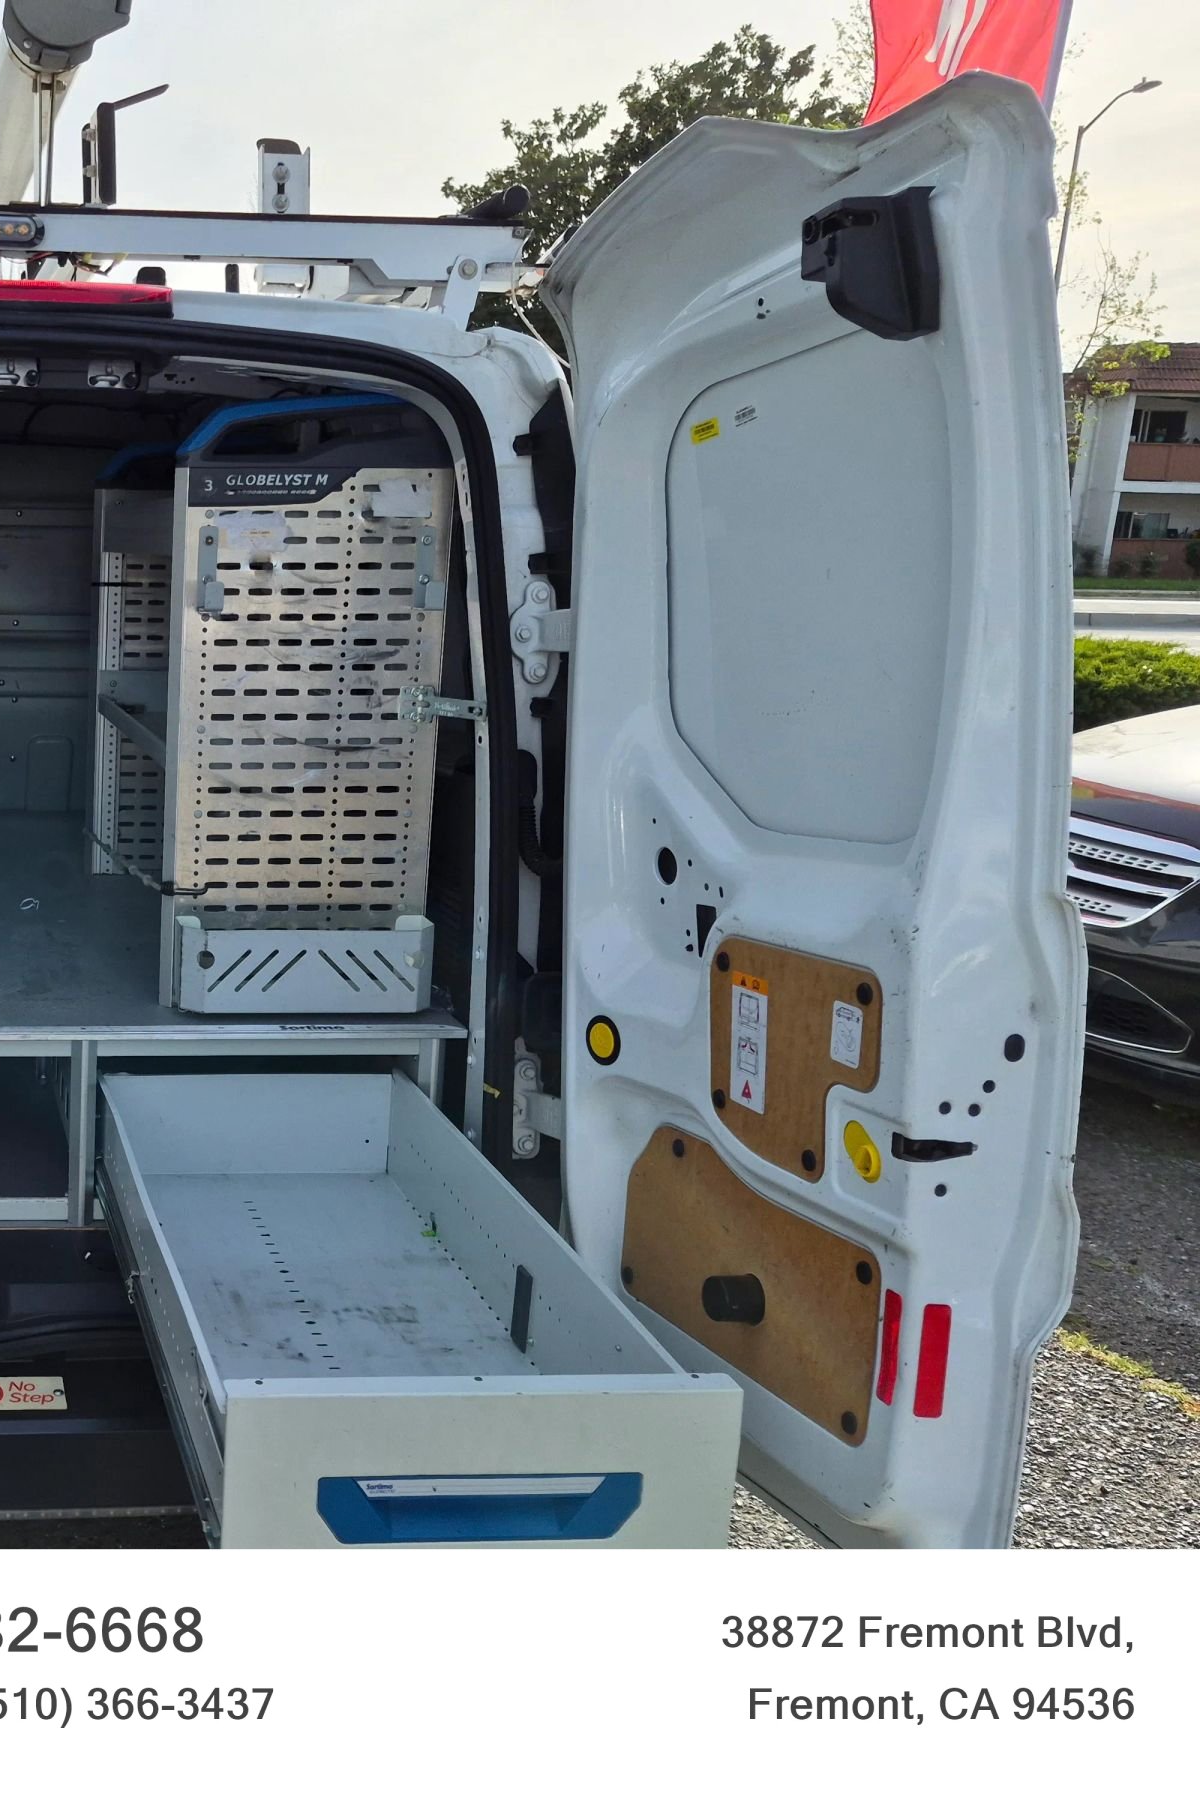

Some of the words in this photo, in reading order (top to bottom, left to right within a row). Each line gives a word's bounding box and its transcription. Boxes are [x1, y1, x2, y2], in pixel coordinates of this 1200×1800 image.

[204, 479, 213, 492] 3
[226, 474, 312, 486] GLOBELYST
[315, 474, 329, 486] M
[8, 1381, 36, 1392] No
[9, 1392, 55, 1405] Step
